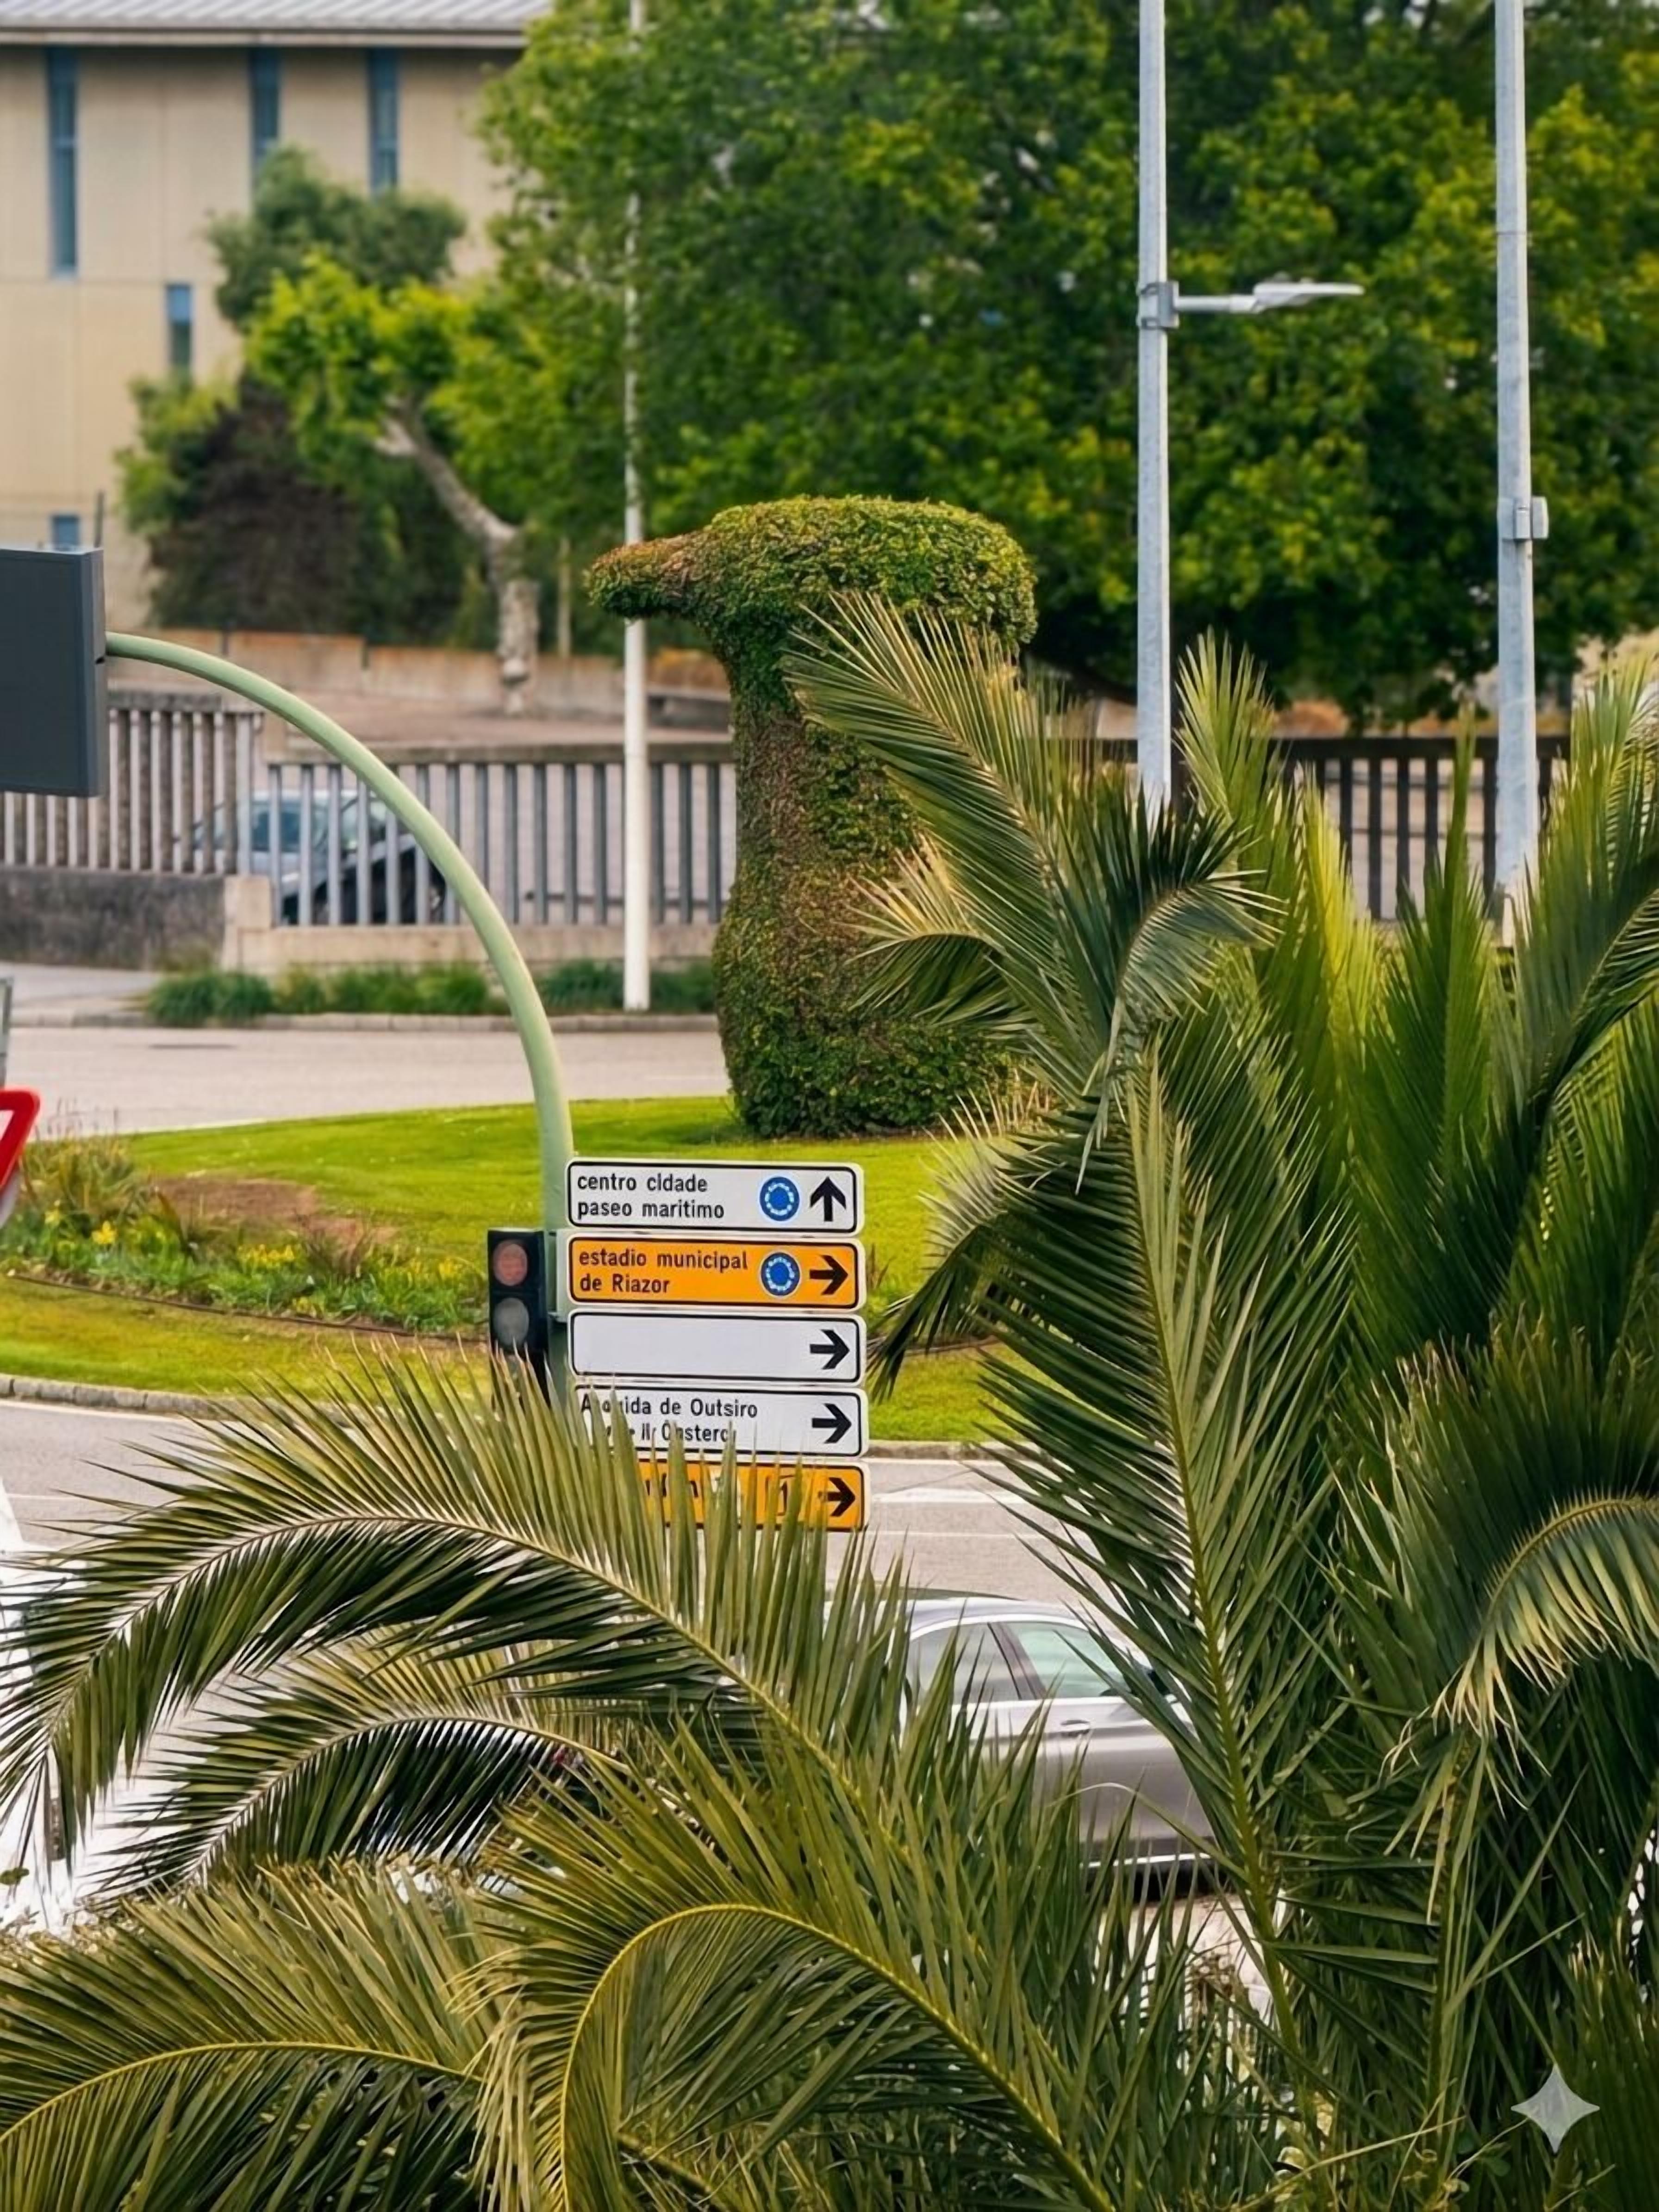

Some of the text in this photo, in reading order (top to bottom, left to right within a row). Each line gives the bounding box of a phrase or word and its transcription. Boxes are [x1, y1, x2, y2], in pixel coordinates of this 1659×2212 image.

[578, 1173, 637, 1191] centro
[578, 1199, 724, 1220] paseo maritimo
[579, 1248, 748, 1273] estadio municipal
[580, 1273, 670, 1293] de Riazor
[660, 1398, 681, 1415] de
